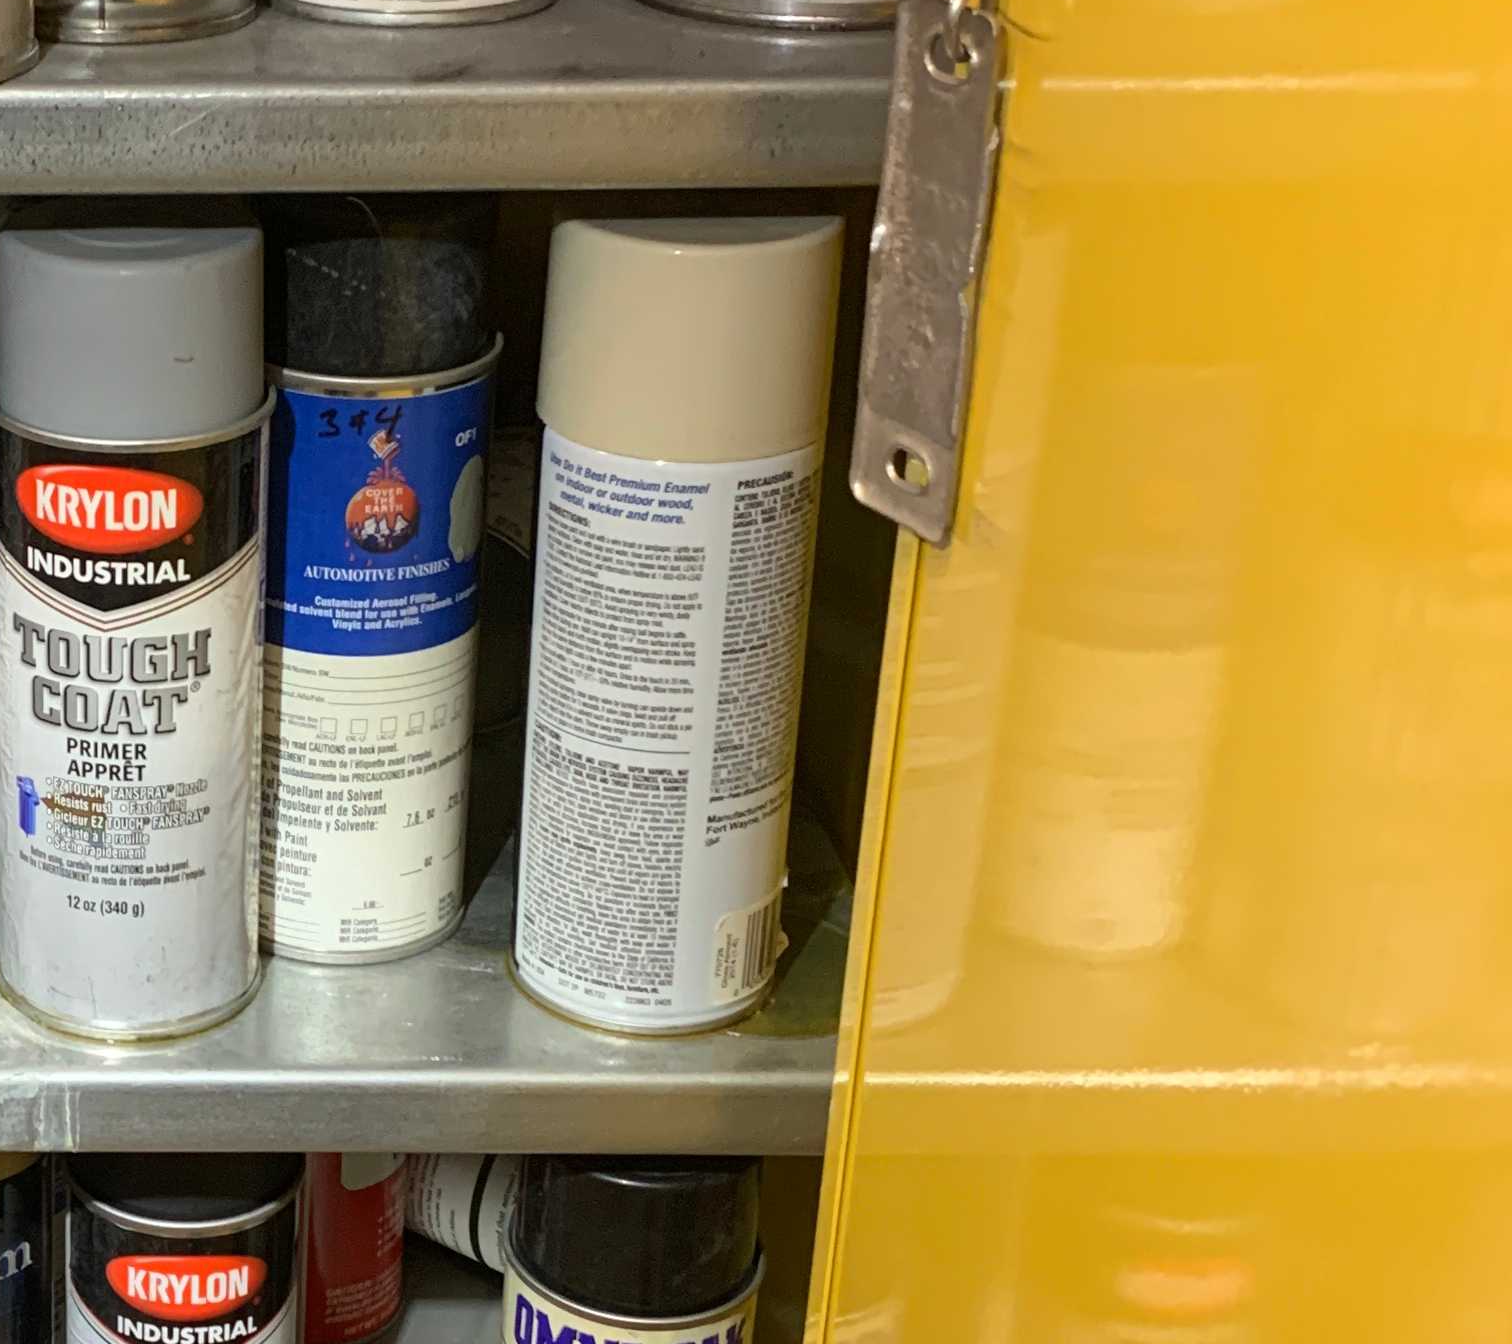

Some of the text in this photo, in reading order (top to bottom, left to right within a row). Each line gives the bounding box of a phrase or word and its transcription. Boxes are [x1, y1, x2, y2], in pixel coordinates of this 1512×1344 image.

[318, 408, 341, 438] 3
[584, 465, 711, 495] Best Premium Enamel
[35, 478, 177, 531] KRYLON
[610, 487, 655, 507] outdoor
[658, 497, 694, 511] wood,
[588, 500, 649, 523] wicker and
[27, 546, 191, 586] INDUSTRIAL
[304, 559, 451, 582] AUTOMOTIVE FINISHES
[314, 595, 370, 609] Customized
[13, 612, 212, 684] TOUGH
[33, 675, 188, 735] COAT
[67, 737, 147, 760] PRIMER
[67, 759, 146, 782] APPRÊT
[53, 793, 88, 811] Resists
[326, 787, 383, 801] and Solvent
[53, 807, 89, 827] Gicleur
[351, 802, 387, 816] Solvant
[284, 830, 308, 847] Paint
[705, 823, 727, 836] Fort
[87, 843, 146, 860] rapidement
[279, 846, 317, 863] peinture
[67, 895, 145, 918] 12 oz (340 g)
[127, 1266, 248, 1305] KRYLON
